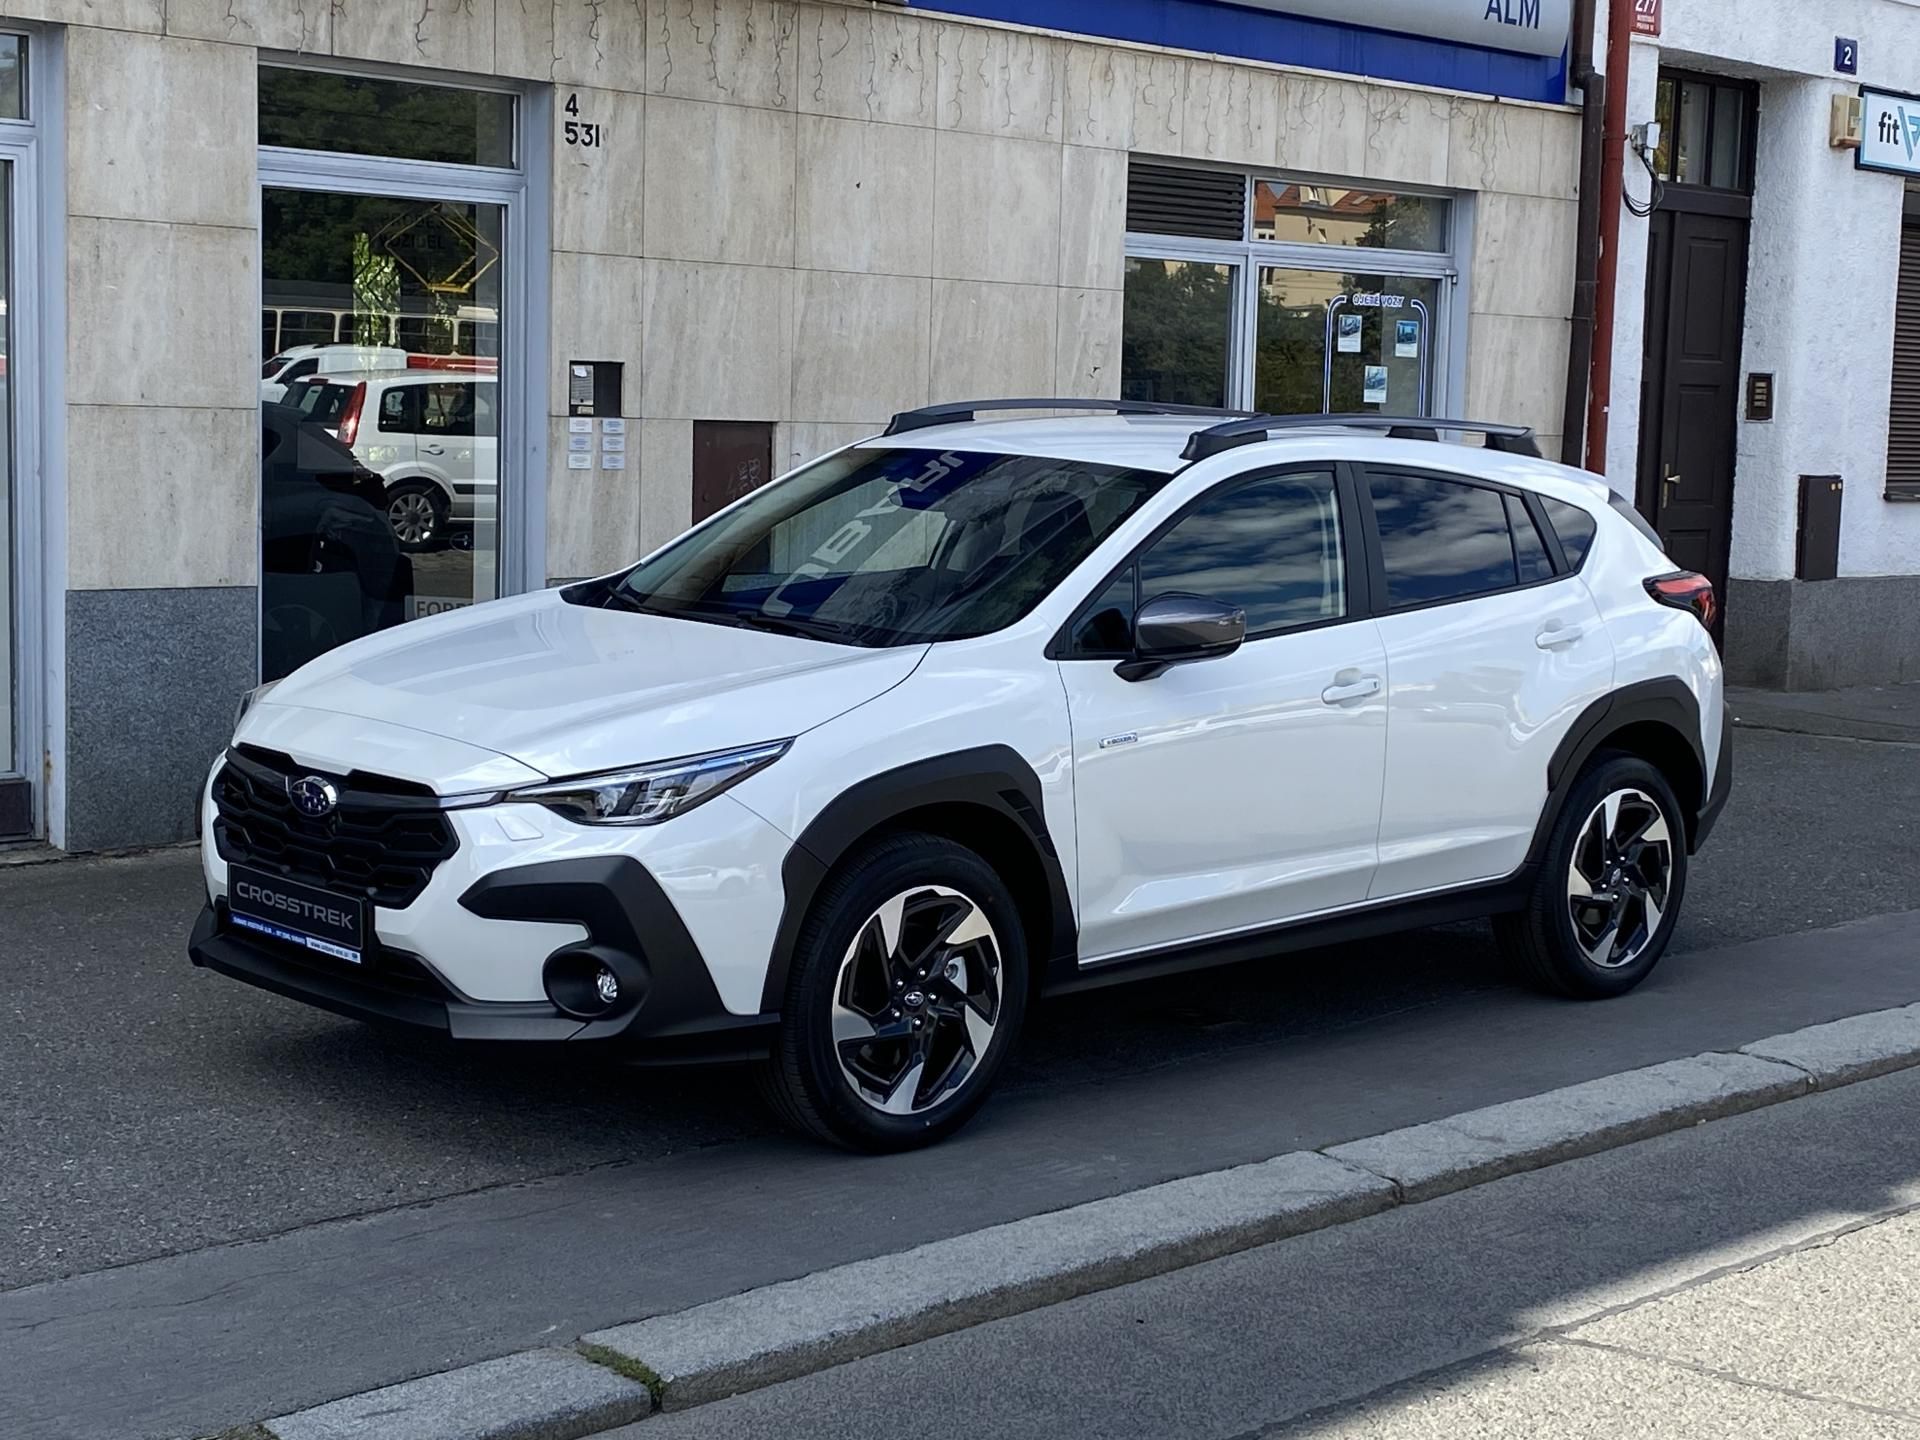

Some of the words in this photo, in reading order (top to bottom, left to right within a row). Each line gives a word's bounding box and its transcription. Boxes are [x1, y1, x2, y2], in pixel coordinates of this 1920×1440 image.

[1483, 0, 1540, 29] ALM
[1843, 46, 1853, 66] 2
[564, 93, 579, 117] 4
[564, 121, 600, 148] 531
[1878, 110, 1900, 146] fit
[236, 881, 354, 931] CROSSTREK
